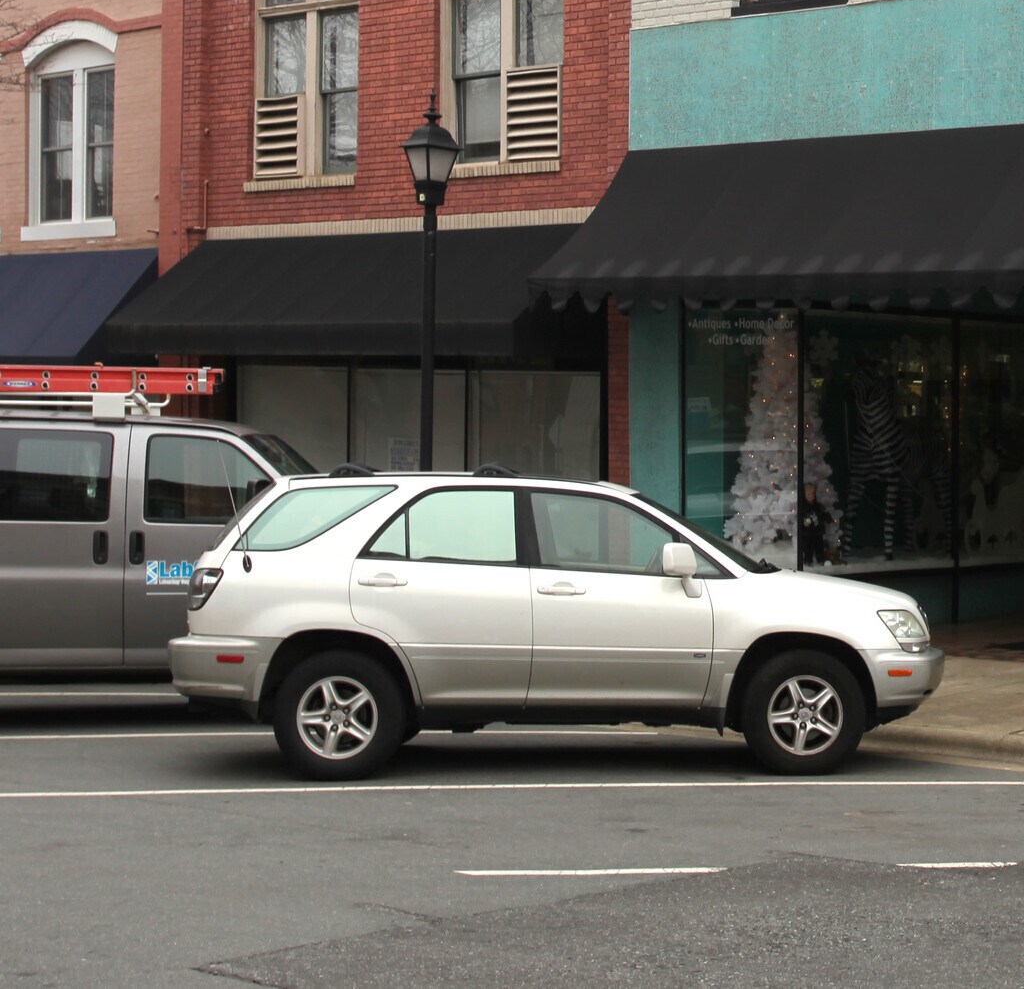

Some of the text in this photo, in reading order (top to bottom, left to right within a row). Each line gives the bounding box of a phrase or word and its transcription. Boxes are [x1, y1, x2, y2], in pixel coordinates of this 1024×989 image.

[692, 318, 795, 330] Antiques Home Decor
[712, 333, 773, 346] Gifts Garden
[159, 561, 199, 578] Lab
